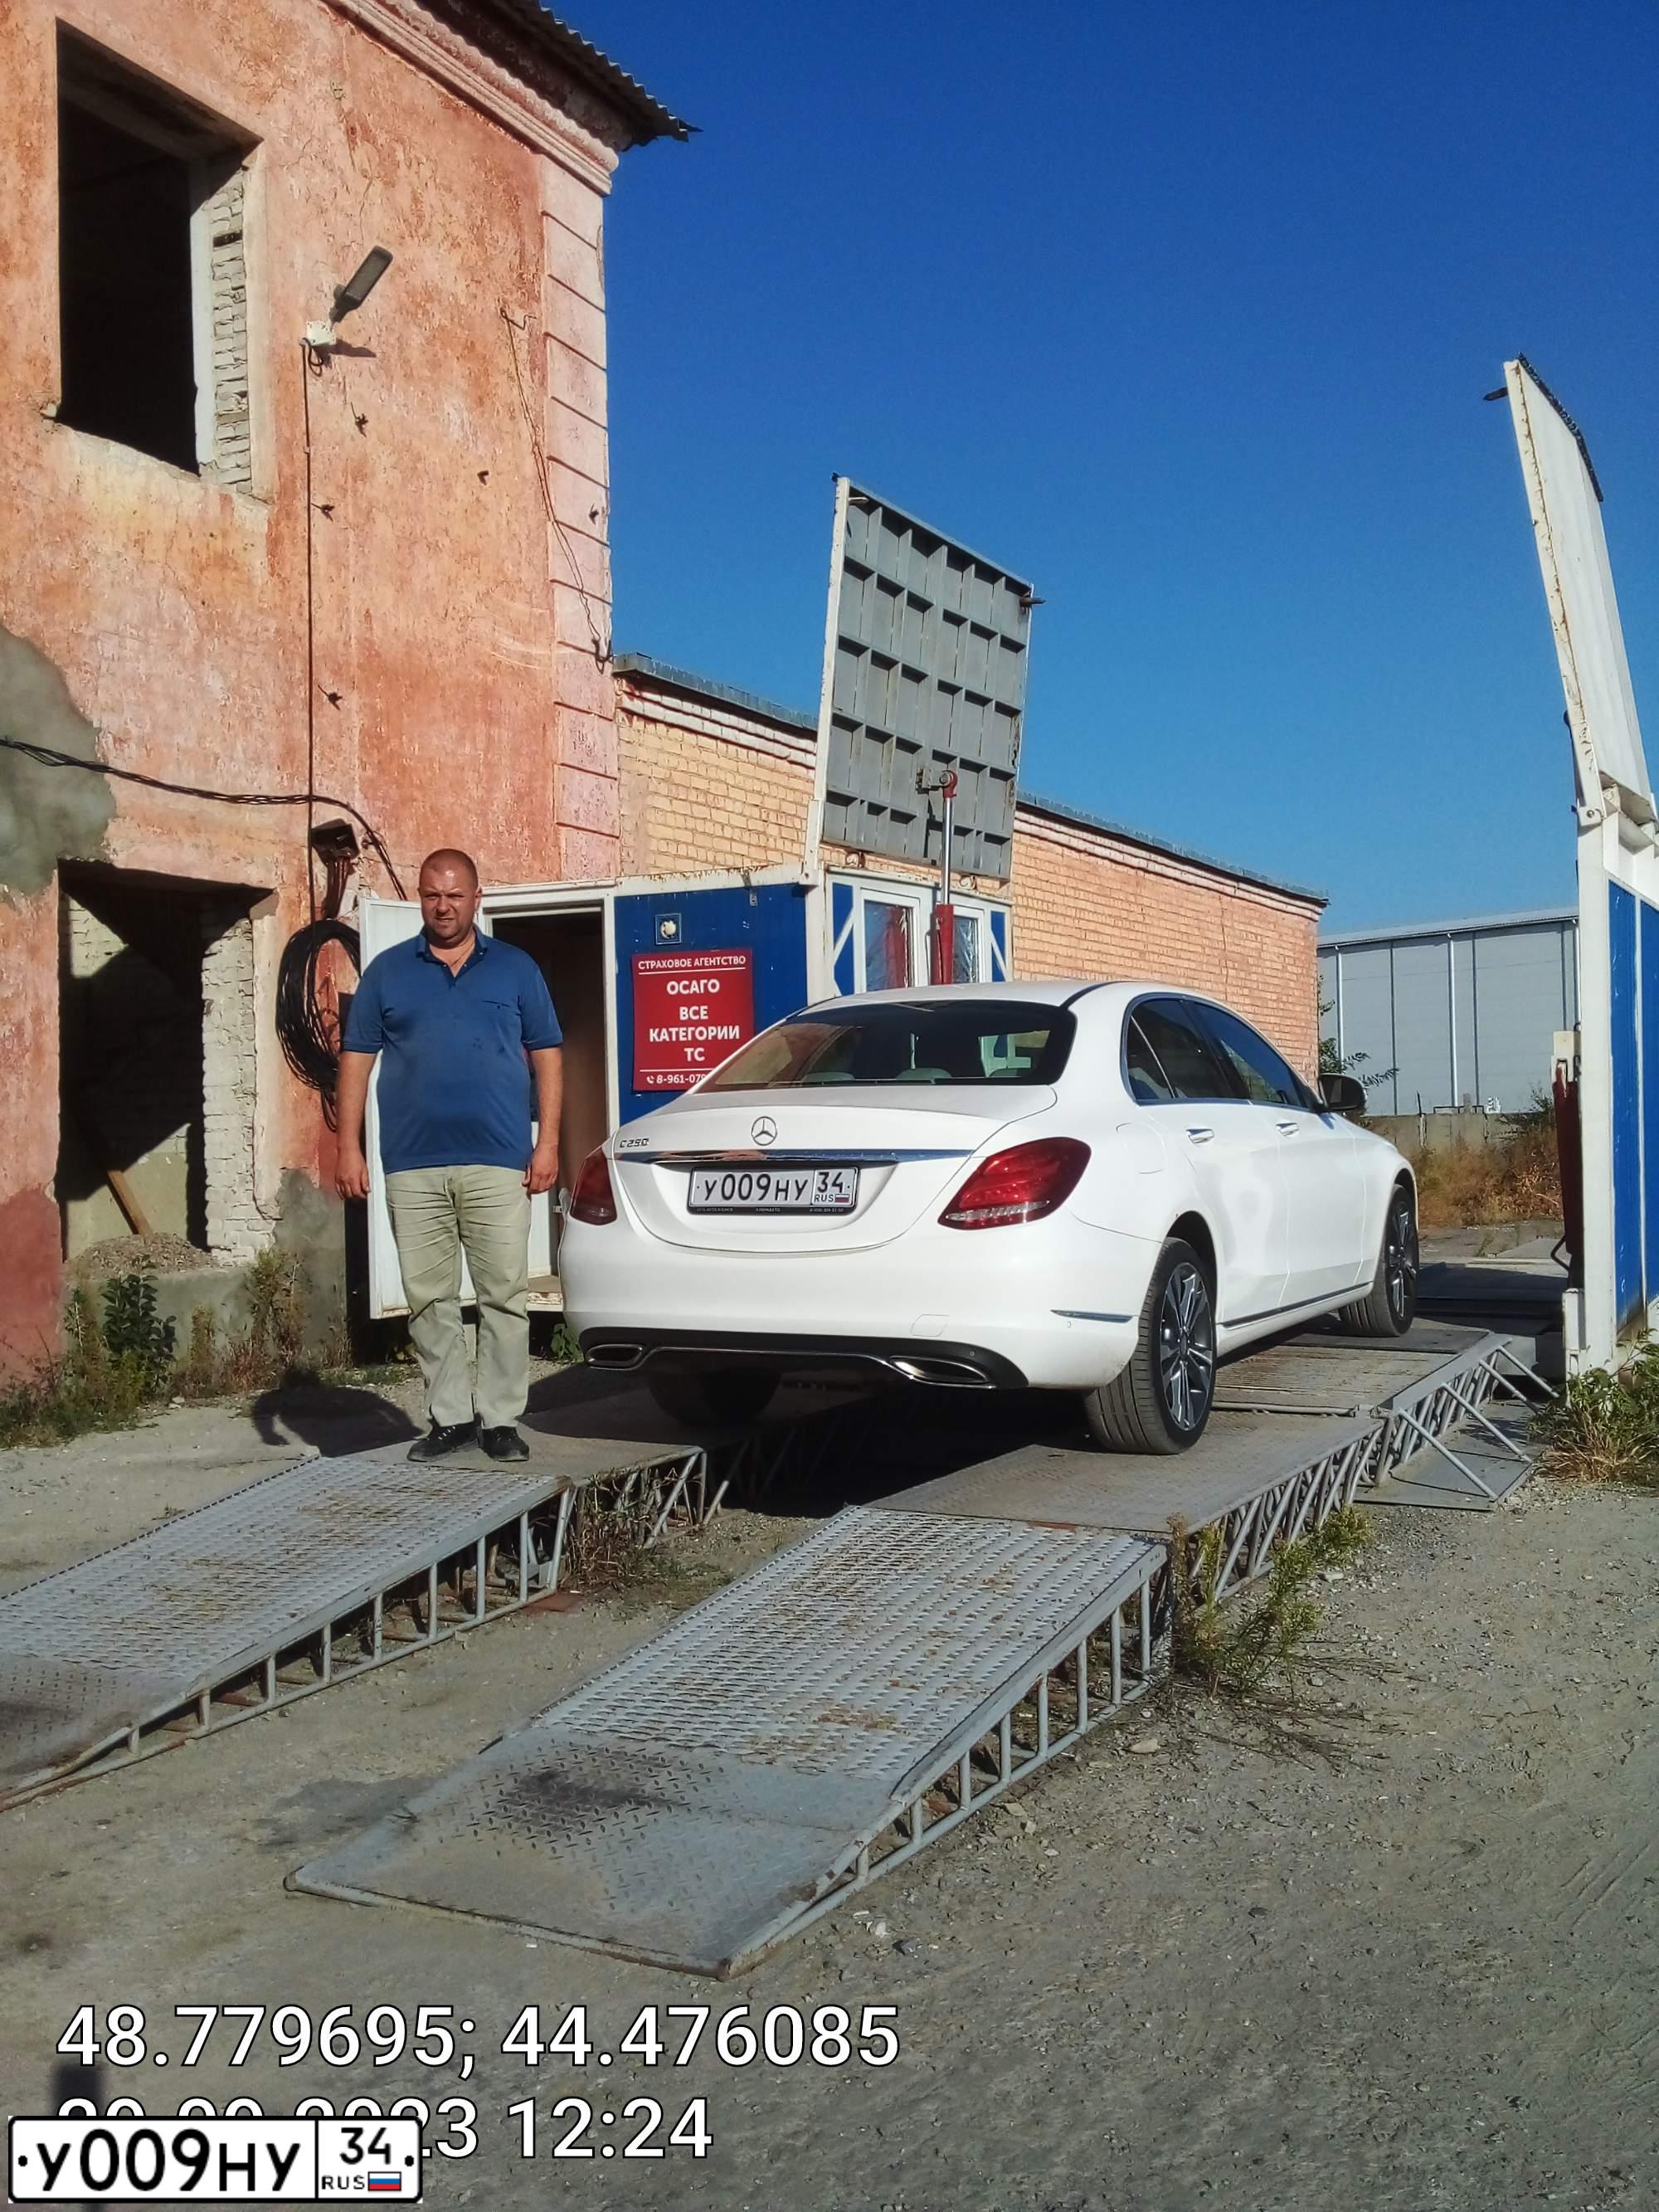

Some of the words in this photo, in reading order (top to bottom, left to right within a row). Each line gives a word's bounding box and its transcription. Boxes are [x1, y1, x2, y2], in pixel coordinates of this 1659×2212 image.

[638, 958, 692, 970] СТРАХОВОЕ
[693, 955, 746, 967] АГЕНТСТВО
[666, 979, 720, 995] ОСАГО
[679, 1006, 708, 1021] ВСЕ
[649, 1026, 740, 1042] КАТЕГОРИИ
[684, 1047, 705, 1062] ТС
[817, 1172, 844, 1193] 34
[814, 1194, 834, 1202] RUS
